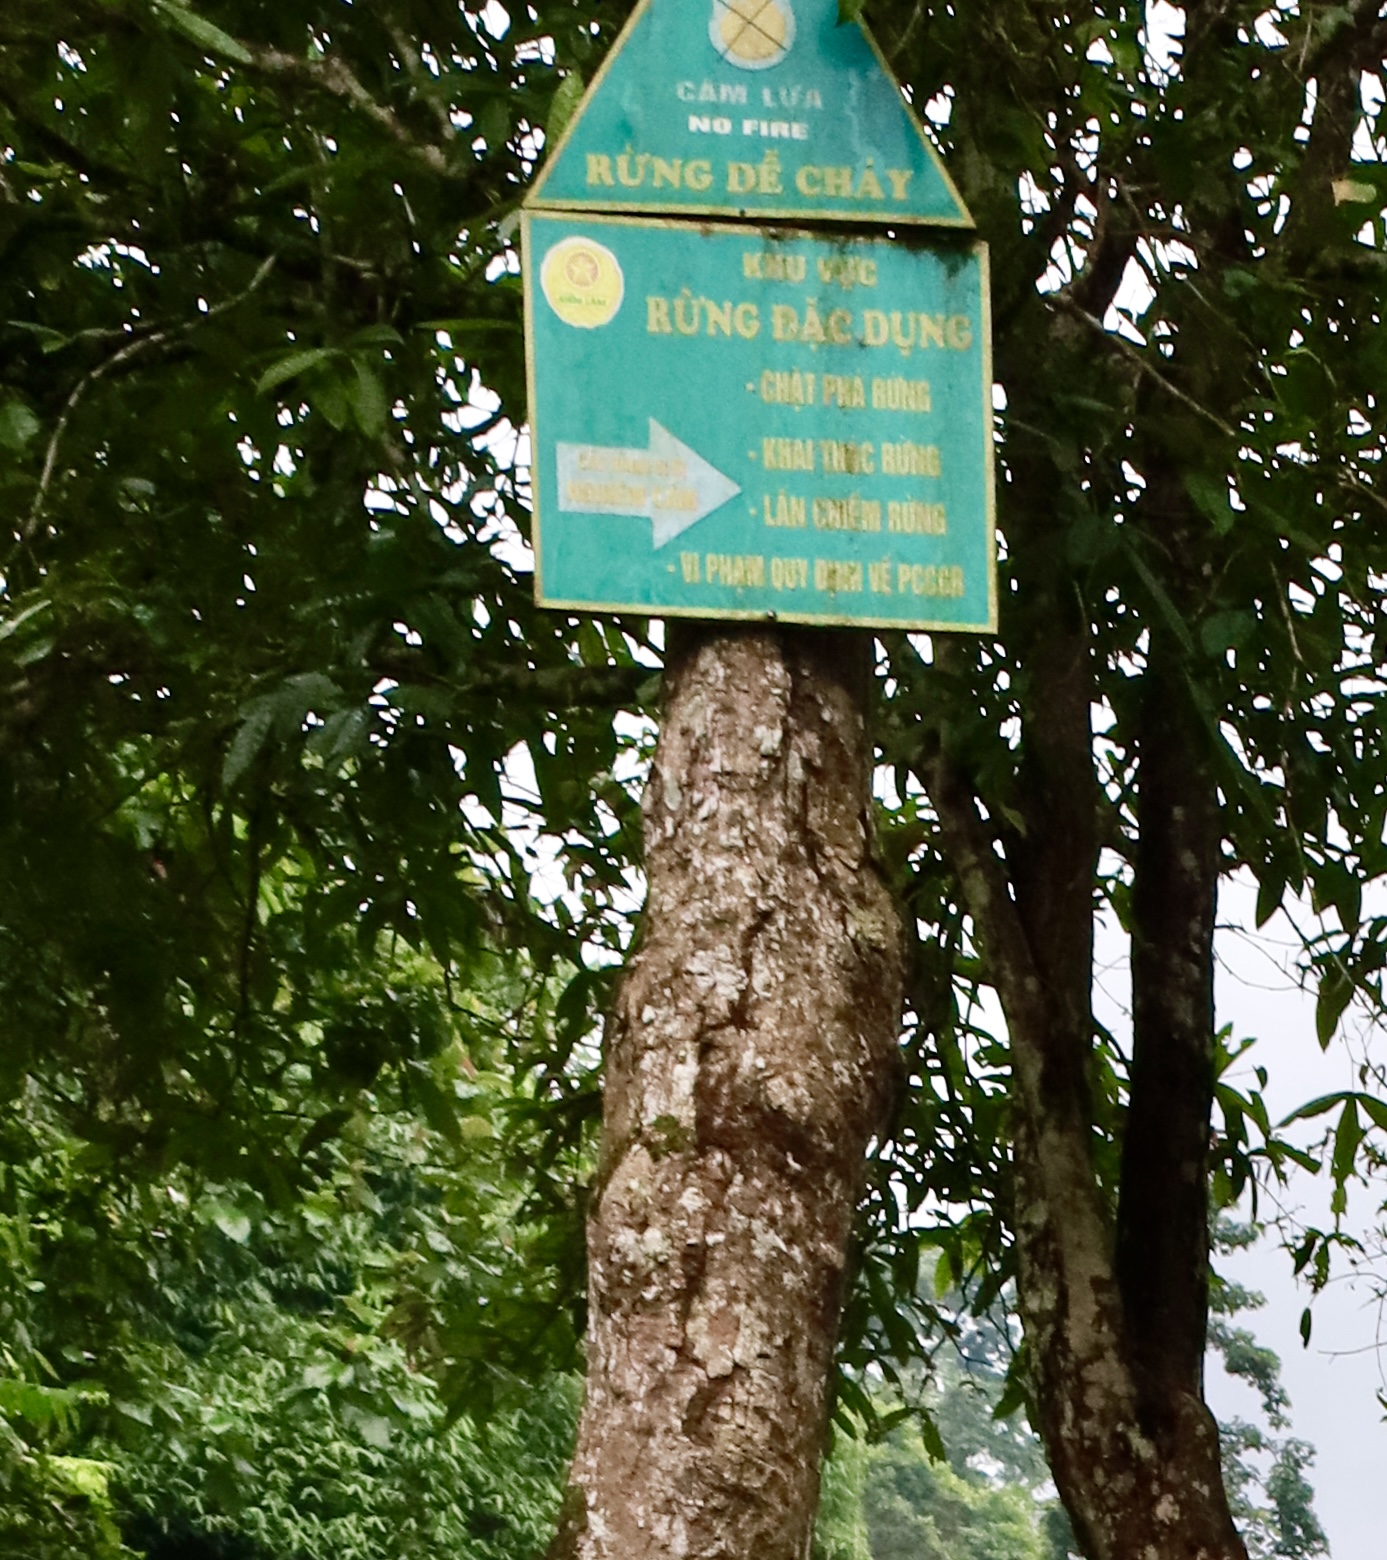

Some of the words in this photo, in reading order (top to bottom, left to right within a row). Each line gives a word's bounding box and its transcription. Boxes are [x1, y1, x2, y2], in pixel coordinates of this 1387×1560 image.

[688, 115, 734, 136] NO
[742, 118, 811, 142] FIRE
[585, 141, 713, 188] RỪNG
[727, 150, 784, 195] DỄ
[742, 252, 806, 283] KHU
[645, 287, 761, 339] RỪNG
[863, 308, 974, 356] DỤNG
[762, 436, 814, 473] KHAI
[680, 551, 700, 584] VI
[770, 557, 808, 592] QUY
